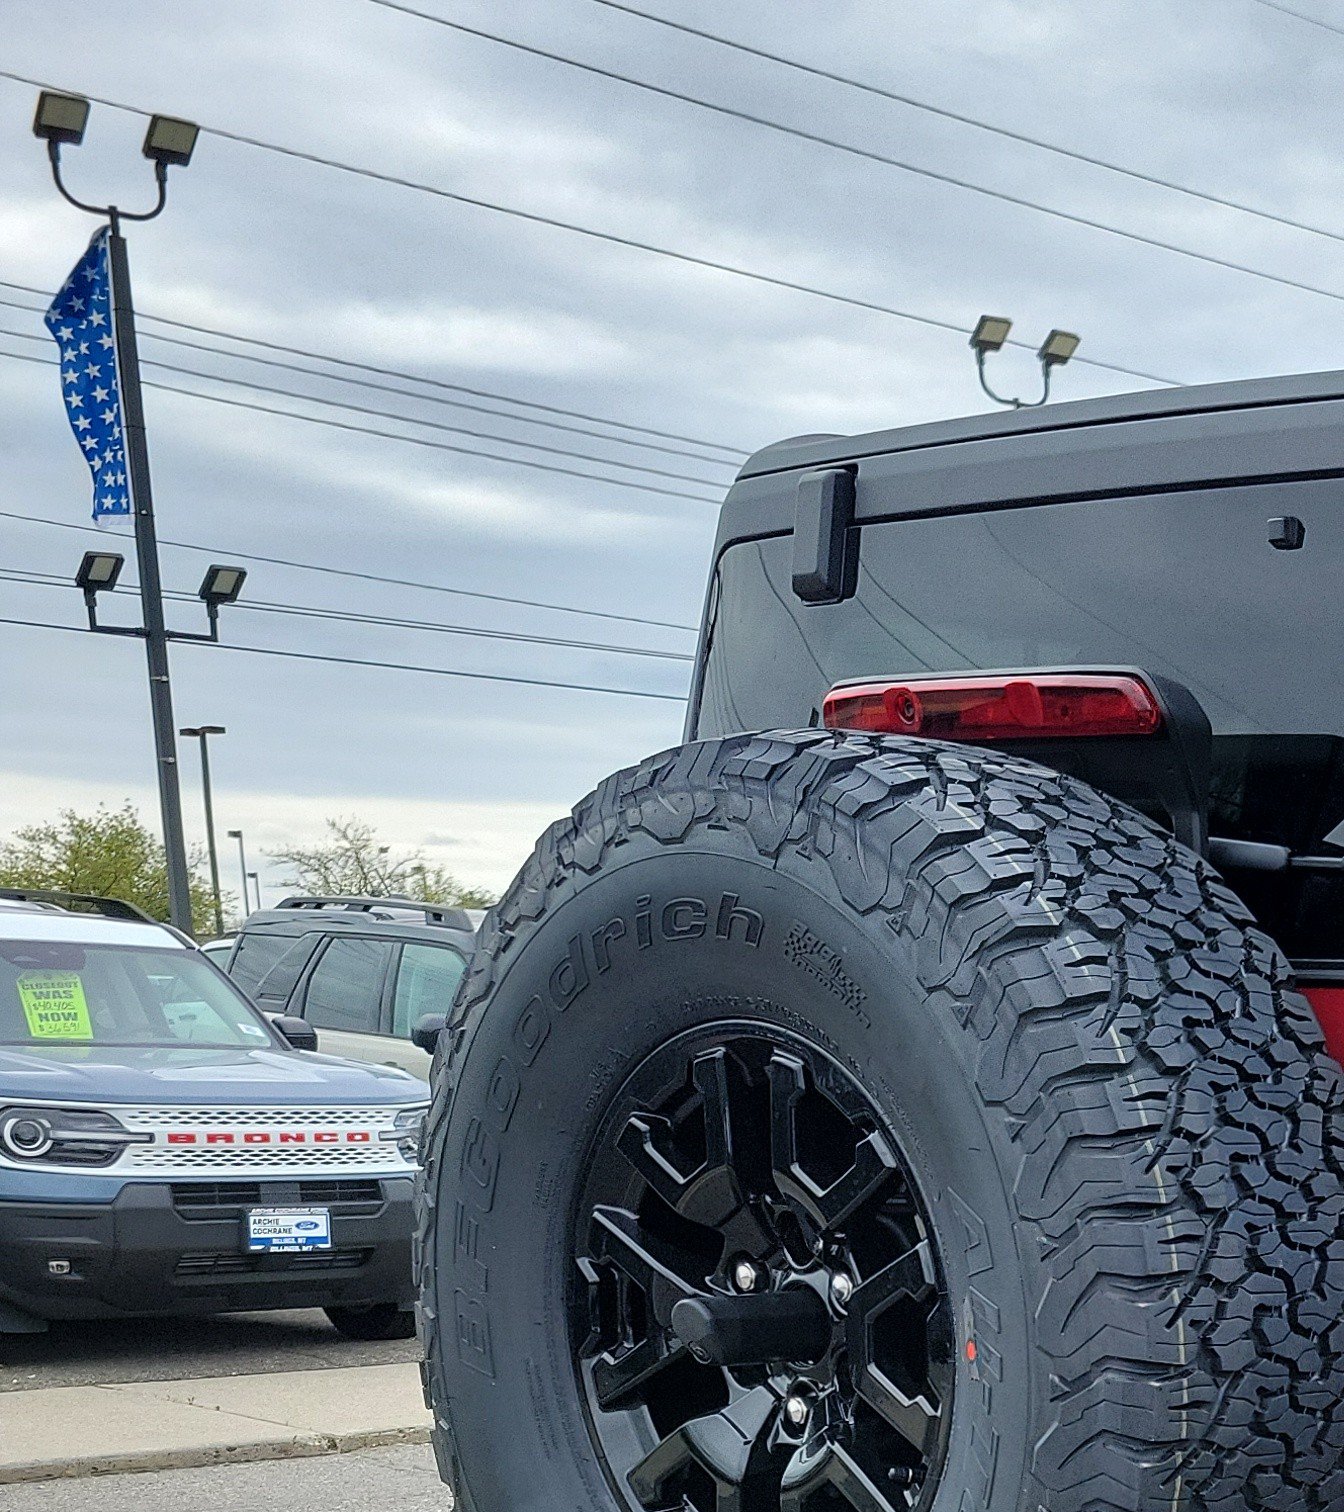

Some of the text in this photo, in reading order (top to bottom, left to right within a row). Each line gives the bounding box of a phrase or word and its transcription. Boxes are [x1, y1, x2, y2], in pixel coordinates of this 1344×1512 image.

[32, 989, 75, 1000] WAS
[38, 1011, 79, 1022] NOW
[167, 1132, 371, 1144] BRONCO
[455, 889, 766, 1380] BFGoodrich
[252, 1218, 280, 1226] ARCHIE
[252, 1227, 293, 1235] COCHRANE
